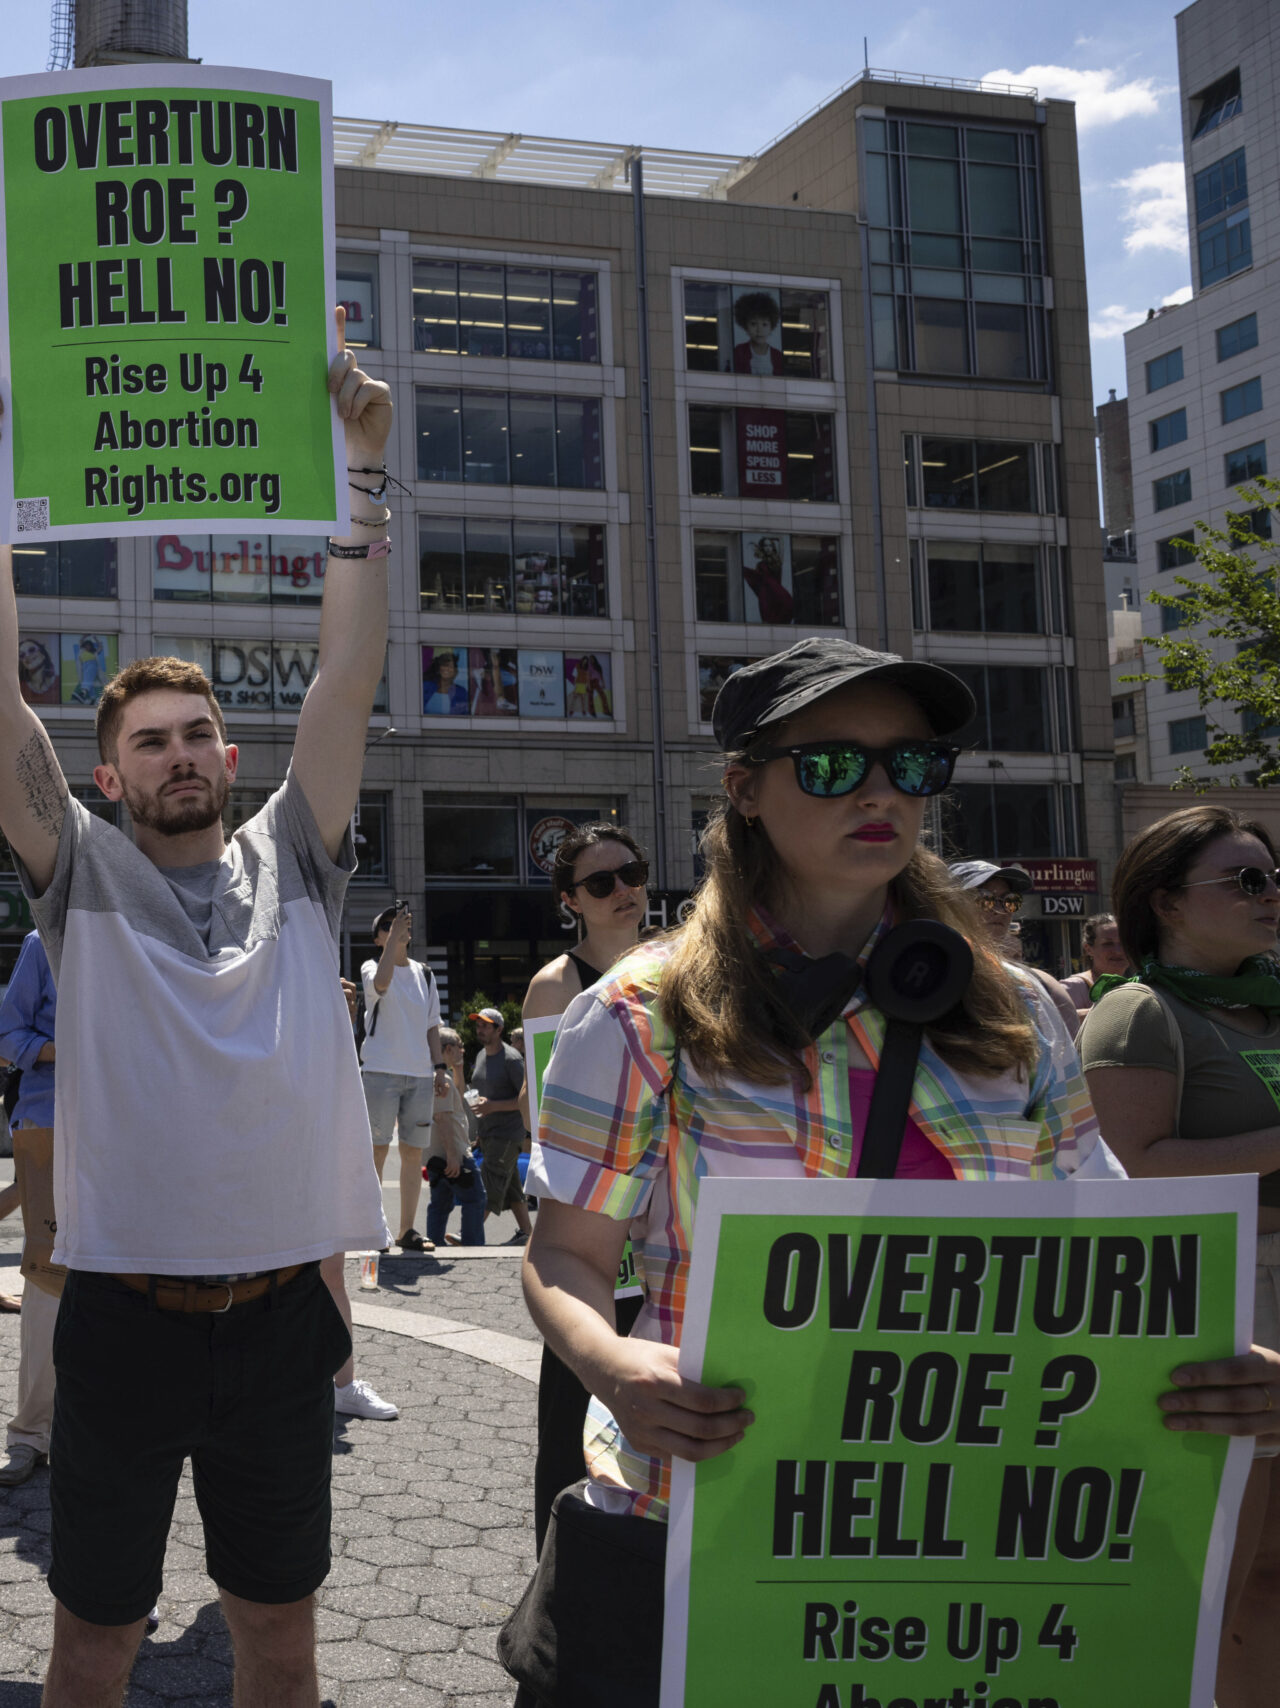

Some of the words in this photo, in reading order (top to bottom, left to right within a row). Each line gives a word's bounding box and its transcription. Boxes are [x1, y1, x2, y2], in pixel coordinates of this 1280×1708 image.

[33, 100, 299, 173] OVERTURN
[95, 178, 198, 247] ROE
[214, 179, 250, 246] ?
[59, 257, 187, 329] HELL
[203, 257, 289, 327] NO!
[85, 354, 168, 396] Rise
[179, 353, 228, 402] Up
[238, 354, 264, 394] 4
[94, 407, 259, 451] Abortion
[746, 424, 778, 438] SHOP
[746, 440, 779, 453] MORE
[746, 455, 780, 468] SPEND
[752, 471, 776, 483] LESS
[84, 464, 282, 516] Rights.org
[213, 645, 320, 688] DSW
[1044, 896, 1083, 914] DSW
[762, 1231, 1201, 1338] OVERTURN
[840, 1350, 1015, 1447] ROE
[1034, 1354, 1100, 1448] ?
[772, 1459, 967, 1560] HELL
[995, 1464, 1145, 1562] NO!
[802, 1600, 928, 1662] Rise
[946, 1602, 1022, 1675] Up
[1037, 1603, 1078, 1662] 4
